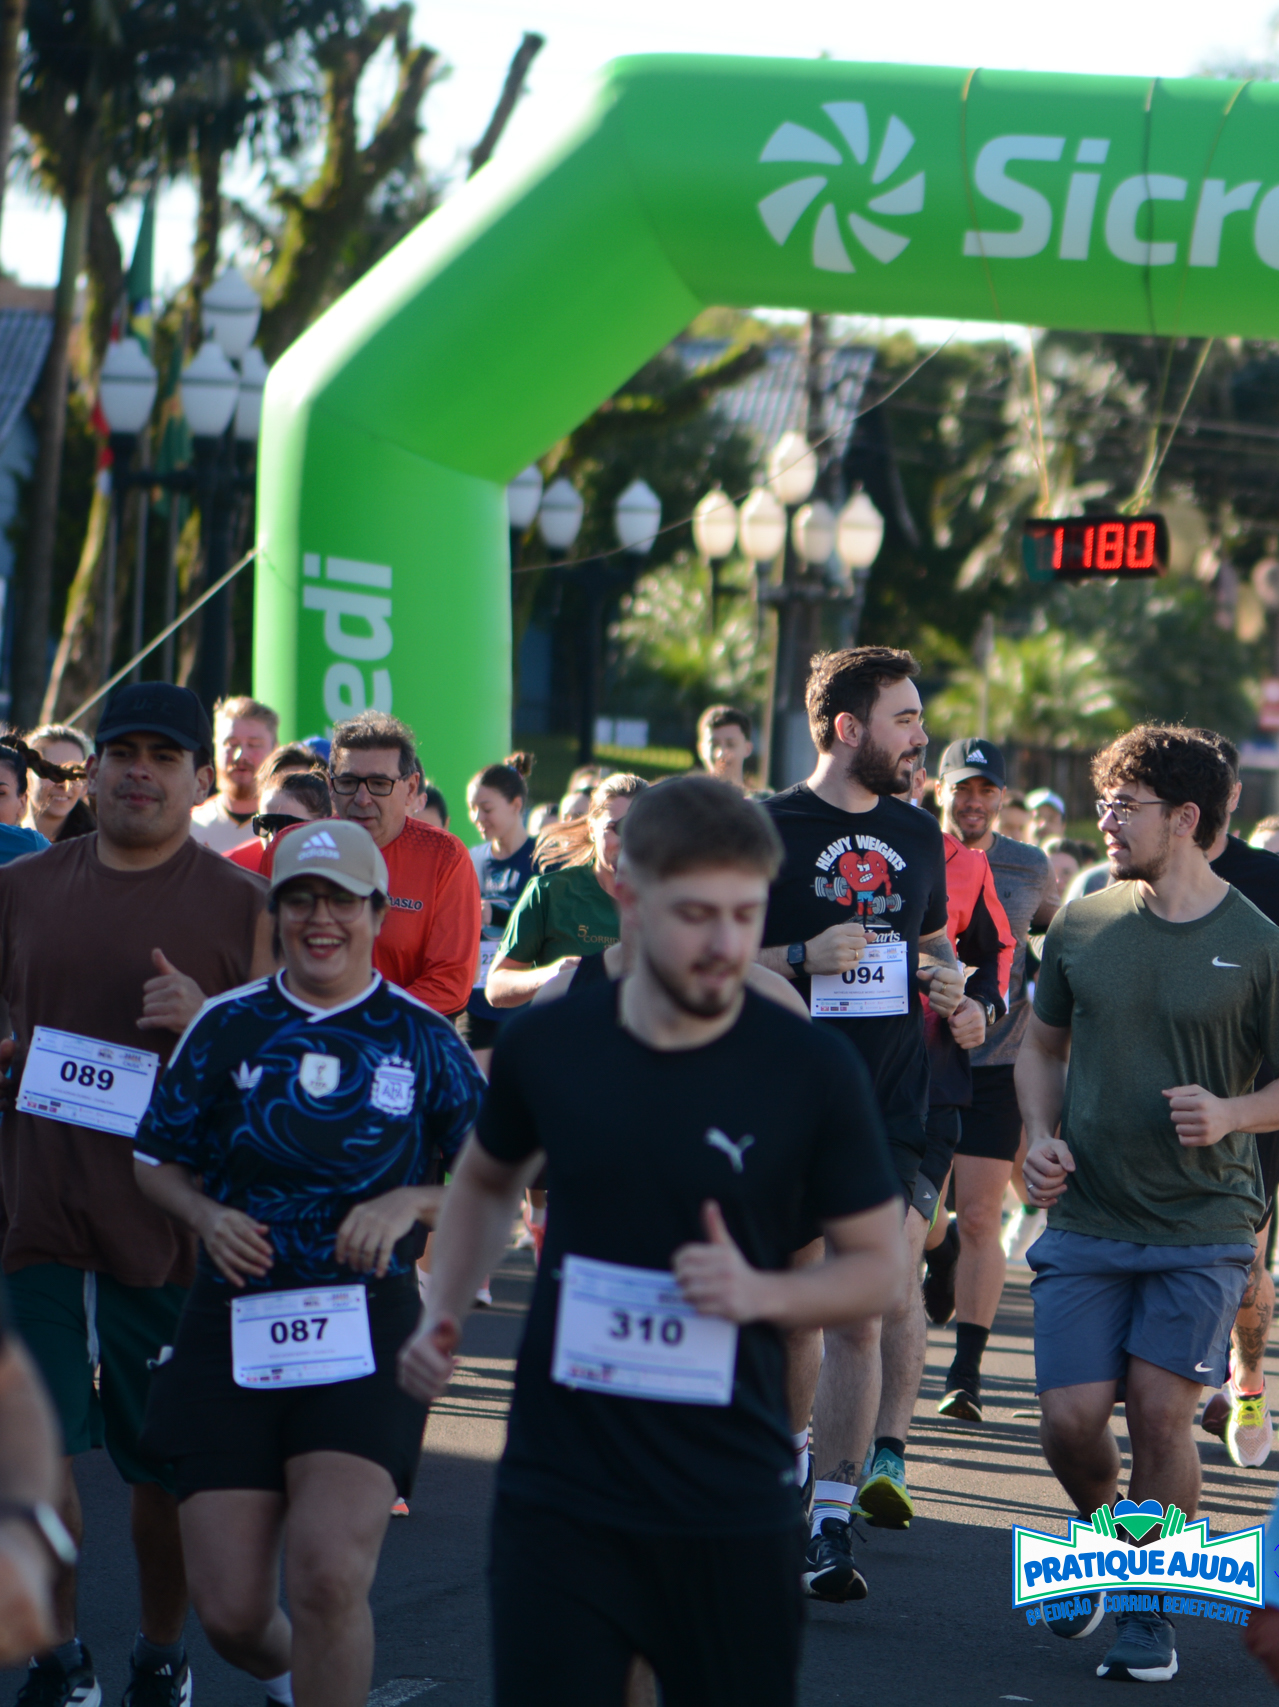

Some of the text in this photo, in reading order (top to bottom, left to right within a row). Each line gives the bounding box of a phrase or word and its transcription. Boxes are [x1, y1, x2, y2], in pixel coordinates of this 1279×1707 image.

[303, 552, 393, 738] edi
[298, 847, 340, 861] adidas
[815, 834, 907, 871] HEAVY WEIGHTS
[583, 934, 620, 945] CORRID
[864, 929, 901, 943] arts
[841, 965, 885, 985] 094
[60, 1060, 115, 1091] 089
[270, 1317, 329, 1344] 087
[608, 1309, 685, 1346] 310
